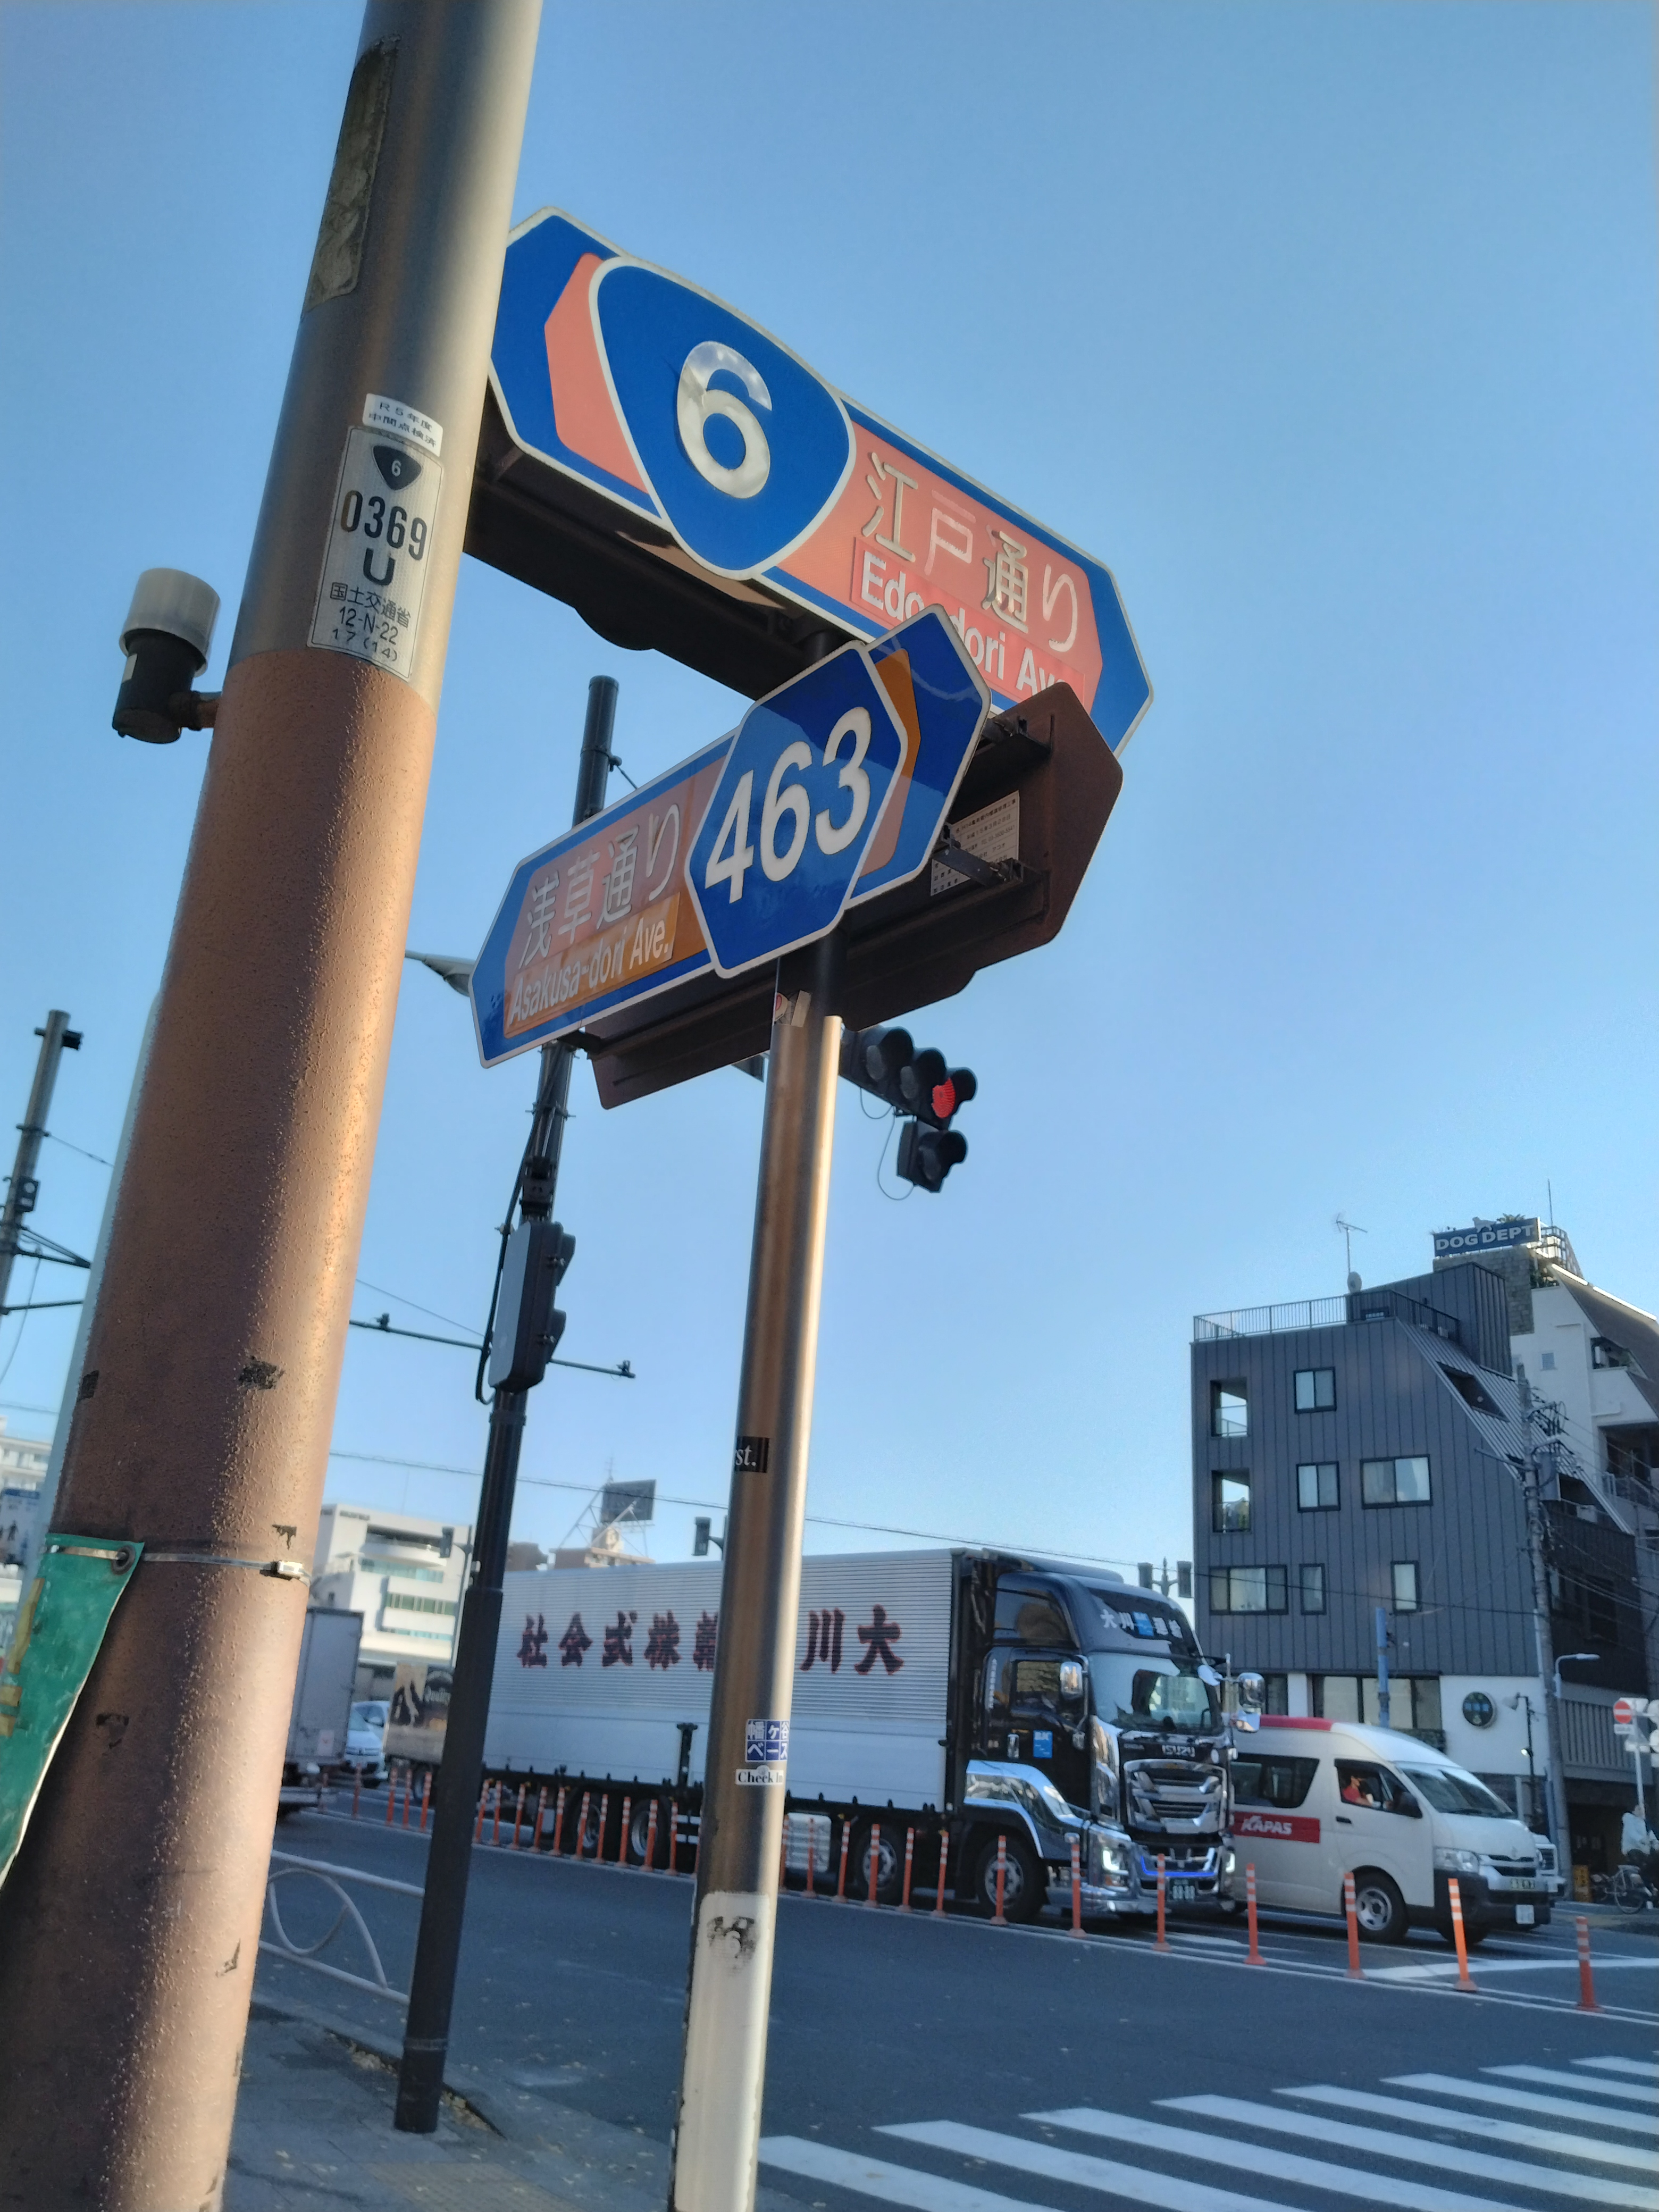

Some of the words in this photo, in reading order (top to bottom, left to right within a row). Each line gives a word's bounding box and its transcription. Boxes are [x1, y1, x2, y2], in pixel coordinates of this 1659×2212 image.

[677, 341, 772, 499] 6
[390, 459, 401, 476] 6
[340, 490, 428, 562] 0369
[363, 548, 395, 587] U
[861, 451, 1078, 652] 江戸通り
[330, 582, 411, 628] 国土交通省
[339, 606, 398, 645] 12-N-22
[861, 551, 1006, 680] Edodori
[1016, 647, 1067, 693] Av
[705, 707, 871, 904] 463
[518, 804, 680, 969] 浅草通り
[509, 932, 626, 1027] Asakusa-dori
[629, 917, 669, 971] Ave.
[1436, 1233, 1479, 1250] DOG
[1482, 1224, 1535, 1243] DEPT
